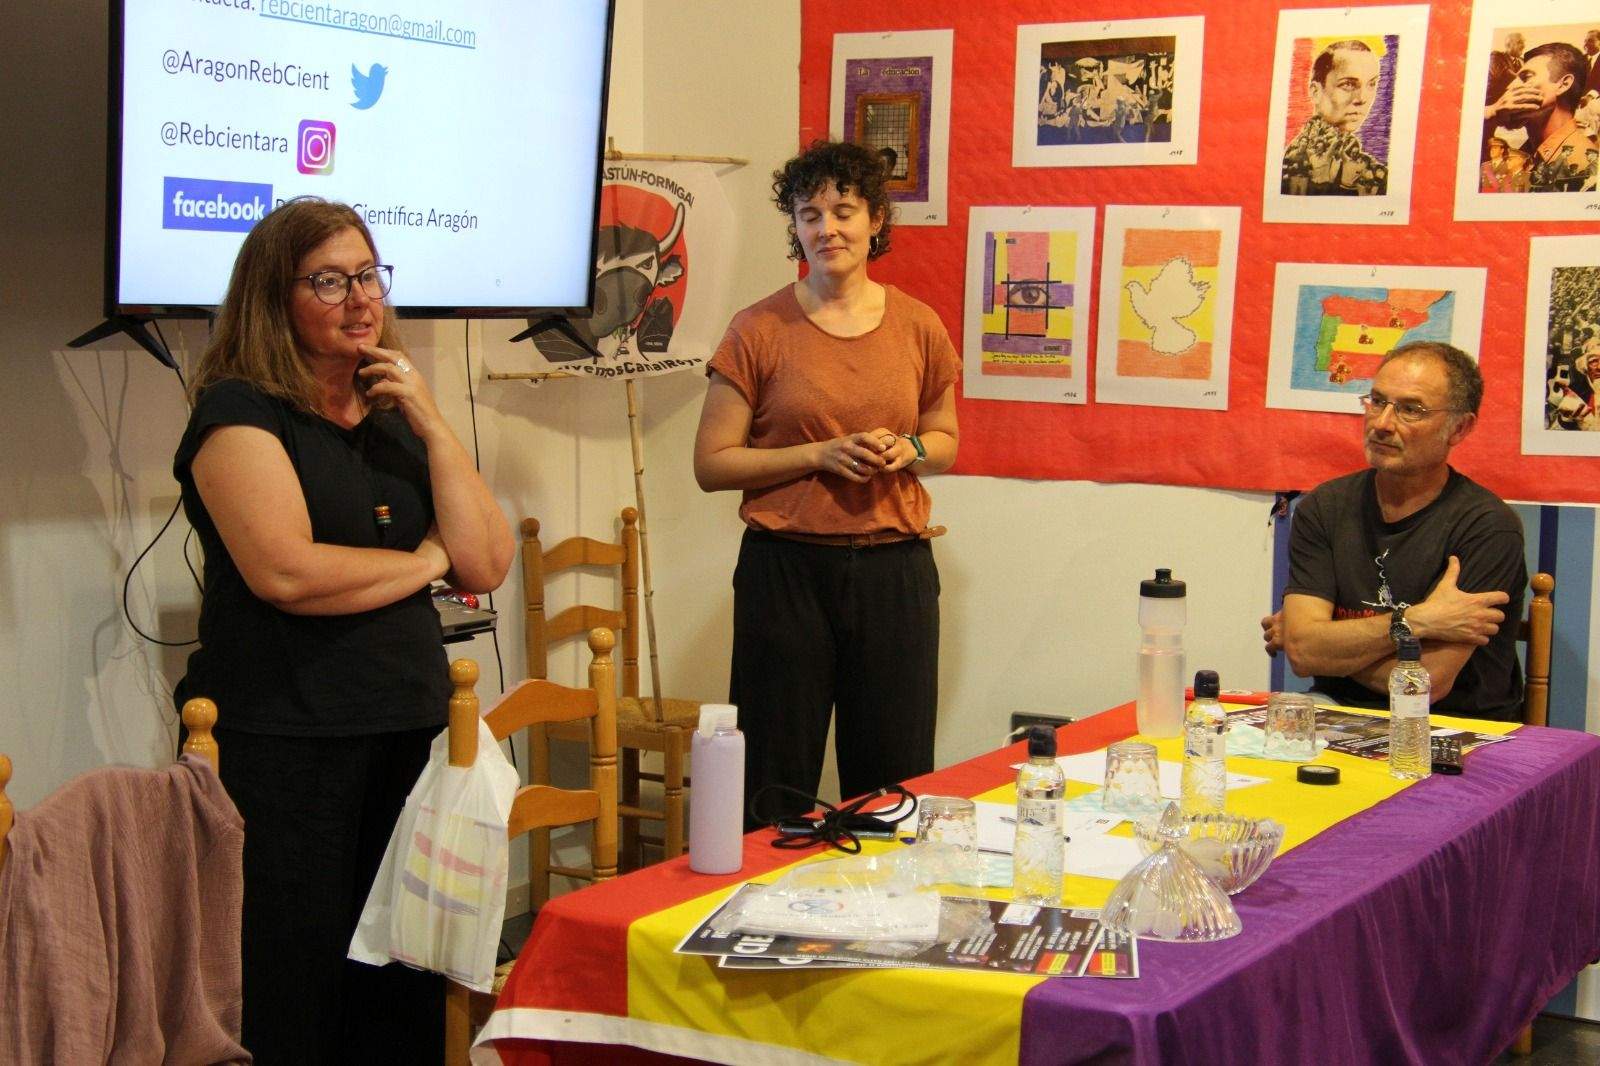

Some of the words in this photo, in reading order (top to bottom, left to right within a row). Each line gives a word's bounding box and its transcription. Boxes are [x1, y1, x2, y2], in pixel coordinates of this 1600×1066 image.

[261, 0, 476, 46] rebcientaragon@gmail.com
[162, 49, 330, 91] @AragonRebCient
[160, 121, 288, 154] @Rebcientara
[173, 190, 265, 221] facebook
[427, 209, 478, 233] Aragón
